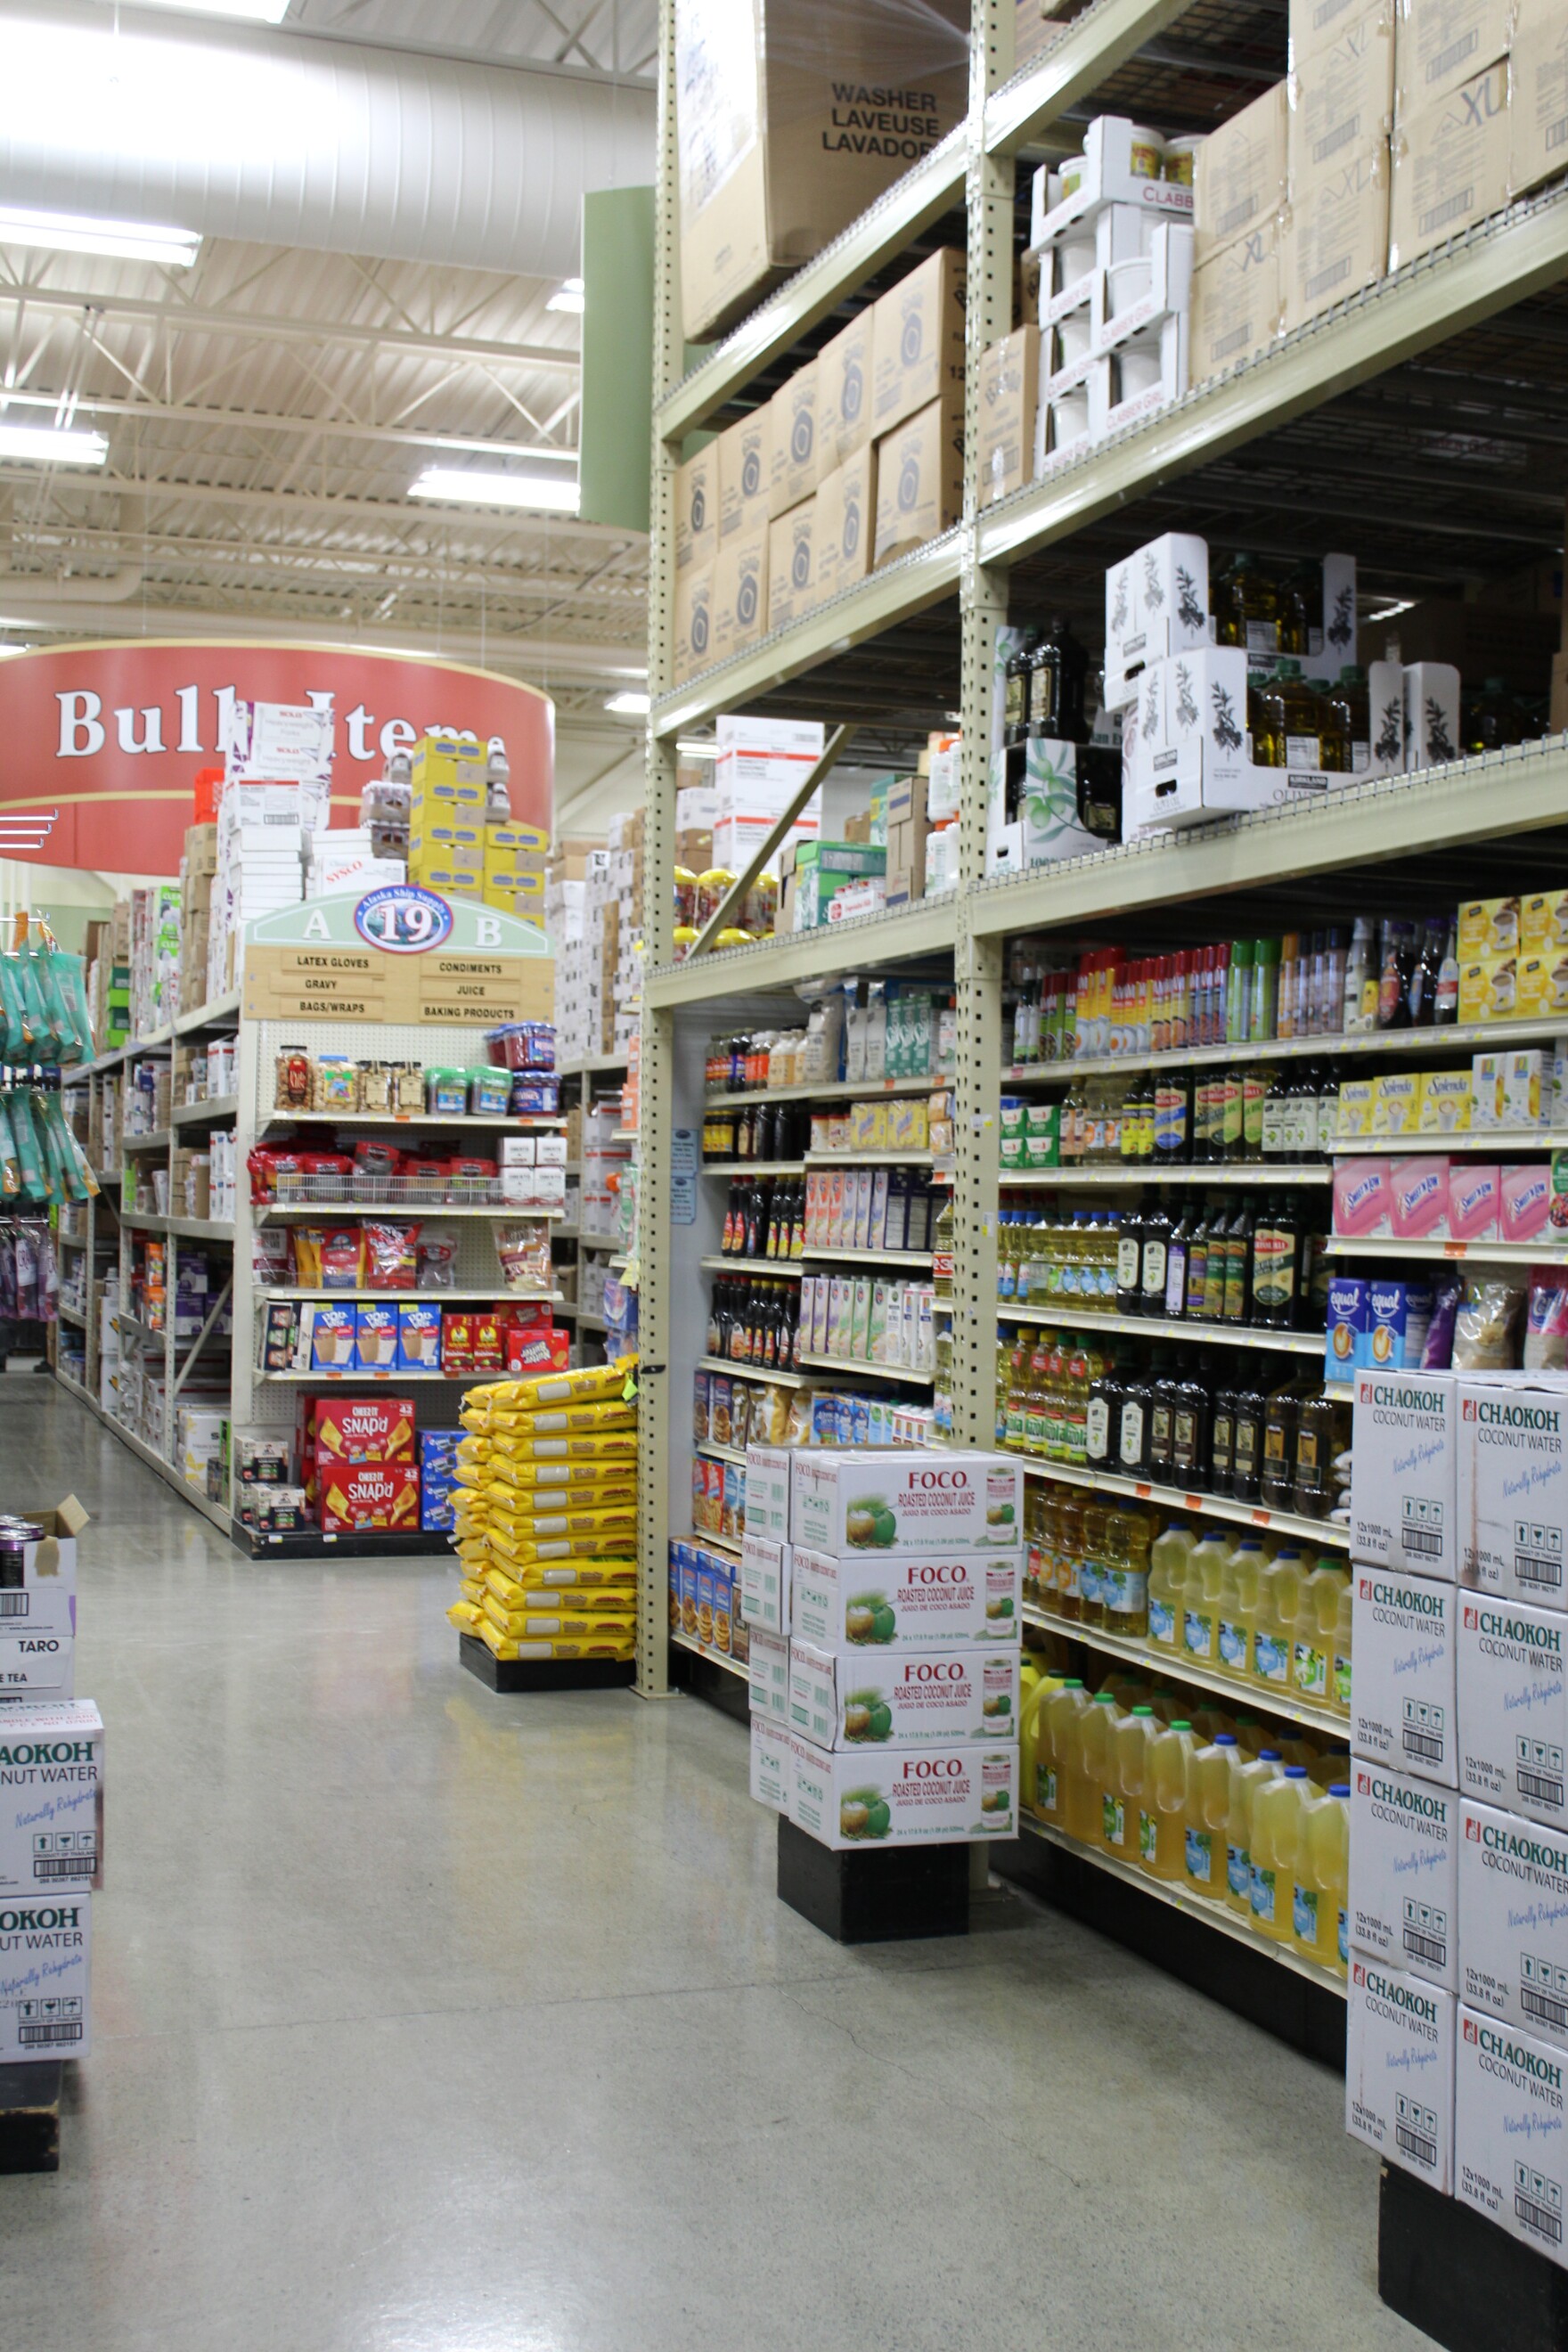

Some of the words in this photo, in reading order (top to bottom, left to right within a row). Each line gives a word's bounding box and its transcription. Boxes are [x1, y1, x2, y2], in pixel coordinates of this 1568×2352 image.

[831, 82, 936, 112] WASHER
[1461, 77, 1503, 127] XL
[830, 107, 940, 136] LAVEUSE
[326, 861, 363, 884] SYSCO
[362, 890, 392, 910] Alaska
[393, 888, 415, 901] Ship
[415, 890, 445, 914] Supply
[303, 909, 332, 941] A
[379, 902, 434, 943] 19
[475, 917, 502, 948] B
[297, 957, 327, 968] LATEX
[331, 958, 369, 968] GLOVES
[439, 962, 502, 975] CONDIMENTS
[306, 980, 337, 990] GRAVY
[457, 985, 486, 996] JUICE
[299, 1001, 365, 1013] BAGS/WRAPS
[424, 1007, 461, 1017] BAKING
[464, 1008, 514, 1019] PRODUCTS
[1379, 1077, 1412, 1098] Splenda
[1428, 1076, 1466, 1096] Splenda
[1331, 1287, 1360, 1310] equal
[1372, 1289, 1400, 1312] equal
[1374, 1386, 1445, 1412] CHAOKOH
[1373, 1409, 1415, 1428] COCONUT
[1416, 1415, 1446, 1433] WATER
[1479, 1402, 1560, 1432] CHAOKOH
[1478, 1428, 1526, 1448] COCONUT
[1528, 1434, 1562, 1453] WATER
[909, 1470, 968, 1490] FOCO
[898, 1492, 927, 1507] ROASTED
[927, 1492, 957, 1507] COCONUT
[958, 1491, 975, 1507] JUICE
[929, 1508, 948, 1516] COCO
[1357, 1521, 1381, 1536] 12x1000
[1383, 1526, 1393, 1539] mL
[908, 1565, 967, 1585] FOCO
[897, 1588, 926, 1603] ROASTED
[927, 1588, 956, 1602] COCONUT
[957, 1587, 975, 1601] JUICE
[1374, 1583, 1444, 1619] CHAOKOH
[901, 1604, 916, 1612] JUGO
[918, 1604, 927, 1612] DE
[929, 1604, 948, 1612] COCO
[1373, 1606, 1415, 1629] COCONUT
[1416, 1616, 1445, 1637] WATER
[1480, 1613, 1562, 1652] CHAOKOH
[19, 1639, 59, 1653] TARO
[1479, 1637, 1527, 1662] COCONUT
[1529, 1648, 1563, 1673] WATER
[8, 1674, 28, 1683] TEA
[904, 1662, 964, 1683] FOCO
[894, 1685, 923, 1699] ROASTED
[924, 1684, 953, 1698] COCONUT
[954, 1683, 972, 1698] JUICE
[897, 1702, 914, 1710] JUGO
[927, 1701, 944, 1709] COCO
[946, 1700, 968, 1708] ASADO
[41, 1767, 97, 1783] WATER
[902, 1759, 962, 1779] FOCO
[893, 1782, 921, 1797] ROASTED
[922, 1781, 951, 1795] COCONUT
[952, 1779, 970, 1794] JUICE
[895, 1798, 912, 1807] JUGO
[913, 1798, 923, 1806] DE
[924, 1797, 943, 1805] COCO
[1372, 1779, 1447, 1823] CHAOKOH
[16, 1803, 54, 1828] Naturally
[1370, 1802, 1416, 1828] COCONUT
[1417, 1817, 1448, 1842] WATER
[1482, 1826, 1568, 1875] CHAOKOH
[1482, 1850, 1531, 1882] COCONUT
[1533, 1867, 1568, 1895] WATER
[26, 1932, 83, 1949] WATER
[1, 1967, 40, 1995] Naturally
[1366, 1972, 1438, 2023] CHAOKOH
[1366, 1996, 1408, 2028] COCONUT
[1408, 2017, 1439, 2044] WATER
[1480, 2028, 1562, 2090] CHAOKOH
[1478, 2054, 1526, 2095] COCONUT
[1529, 2079, 1564, 2111] WATER
[1462, 2164, 1490, 2193] 12x1000
[1492, 2184, 1504, 2201] mL
